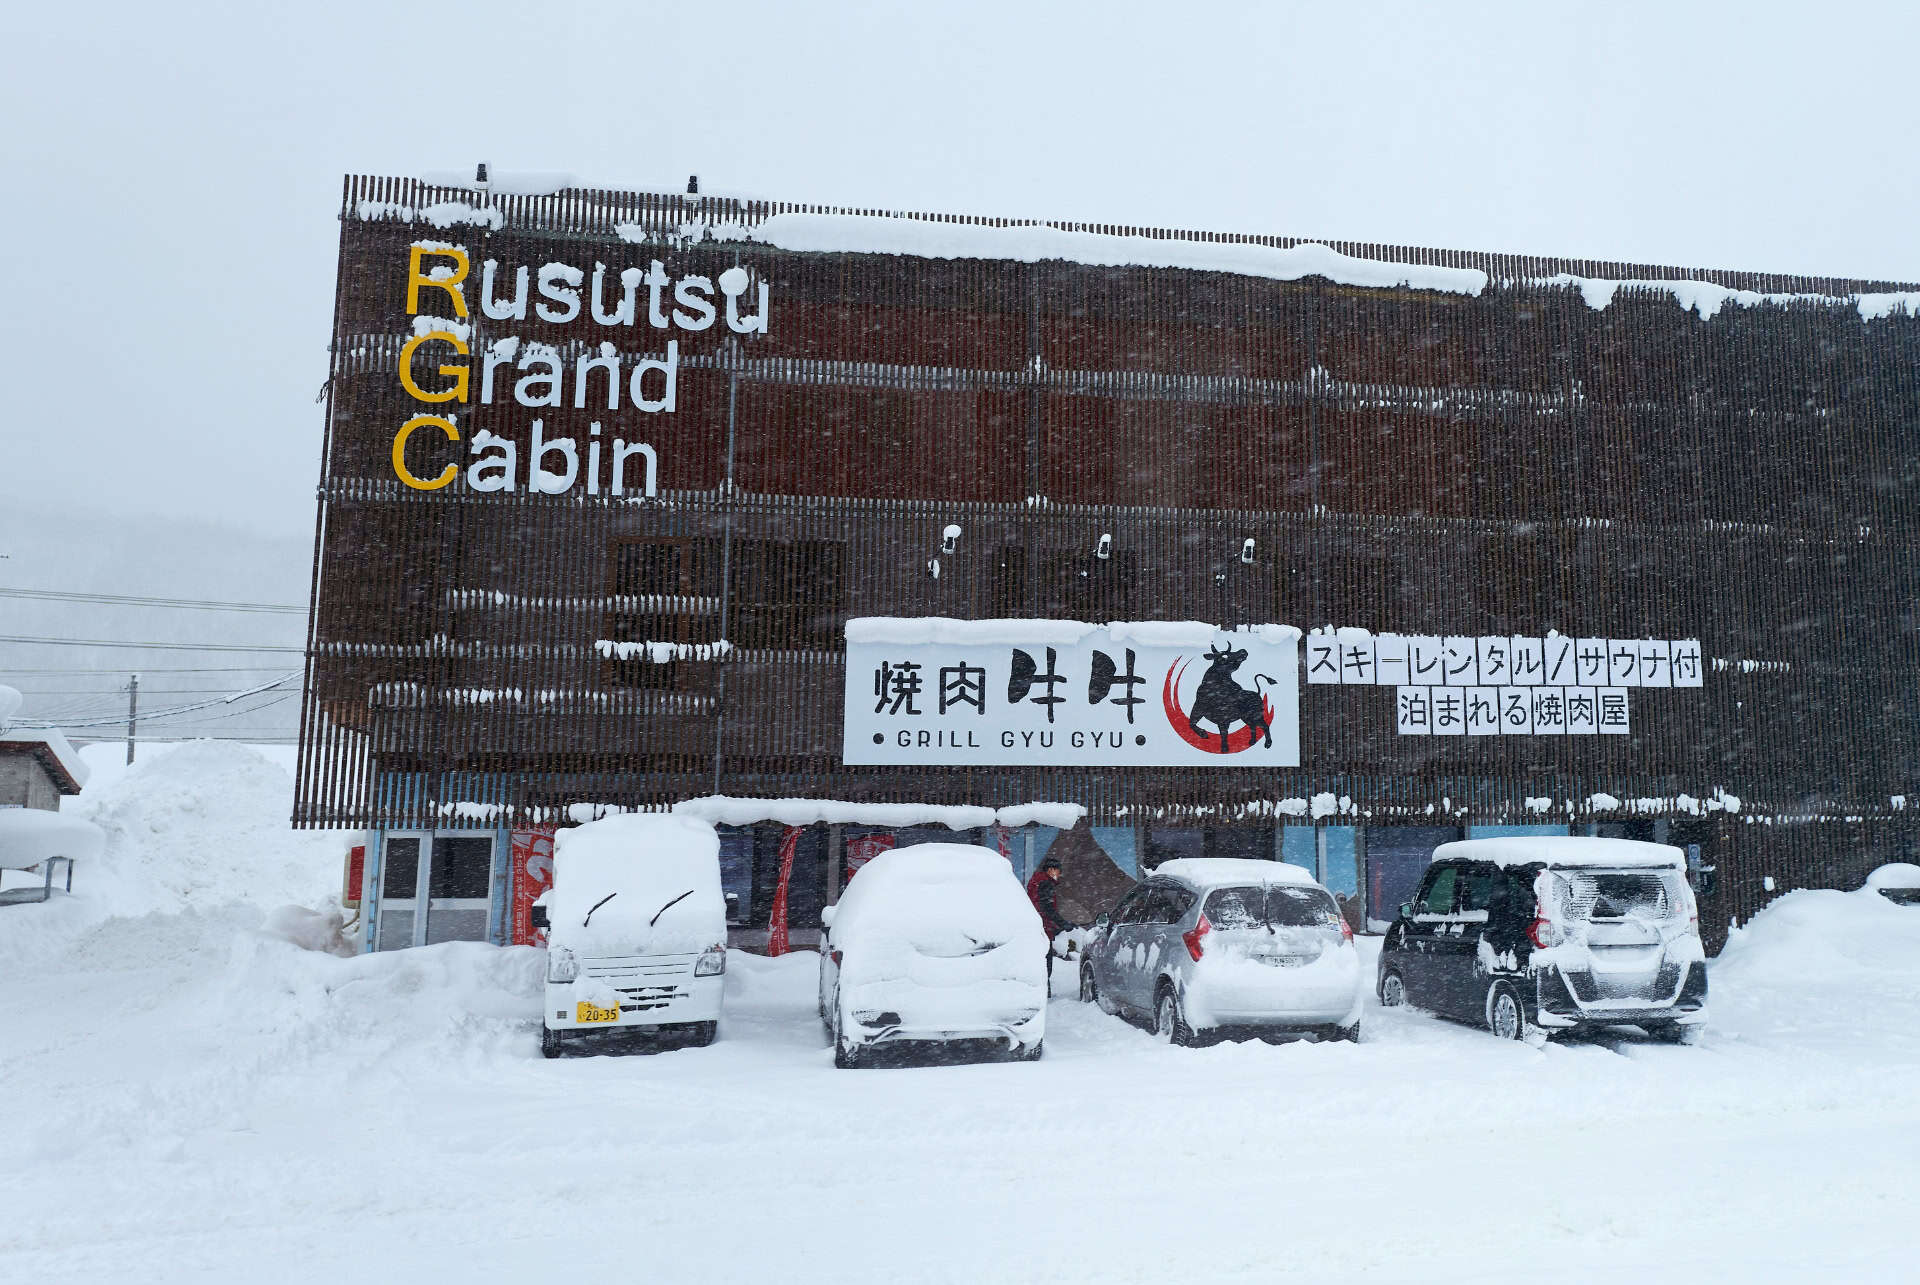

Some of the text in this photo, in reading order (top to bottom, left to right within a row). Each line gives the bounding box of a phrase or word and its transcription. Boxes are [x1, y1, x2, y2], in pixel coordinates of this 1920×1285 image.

[406, 244, 769, 334] Rusutsu
[399, 330, 678, 412] Grand
[392, 415, 657, 497] Cabin
[1400, 694, 1628, 726] 泊まれる焼肉屋
[897, 730, 1123, 748] GRILL GYU GYU
[585, 1008, 617, 1021] 20-35
